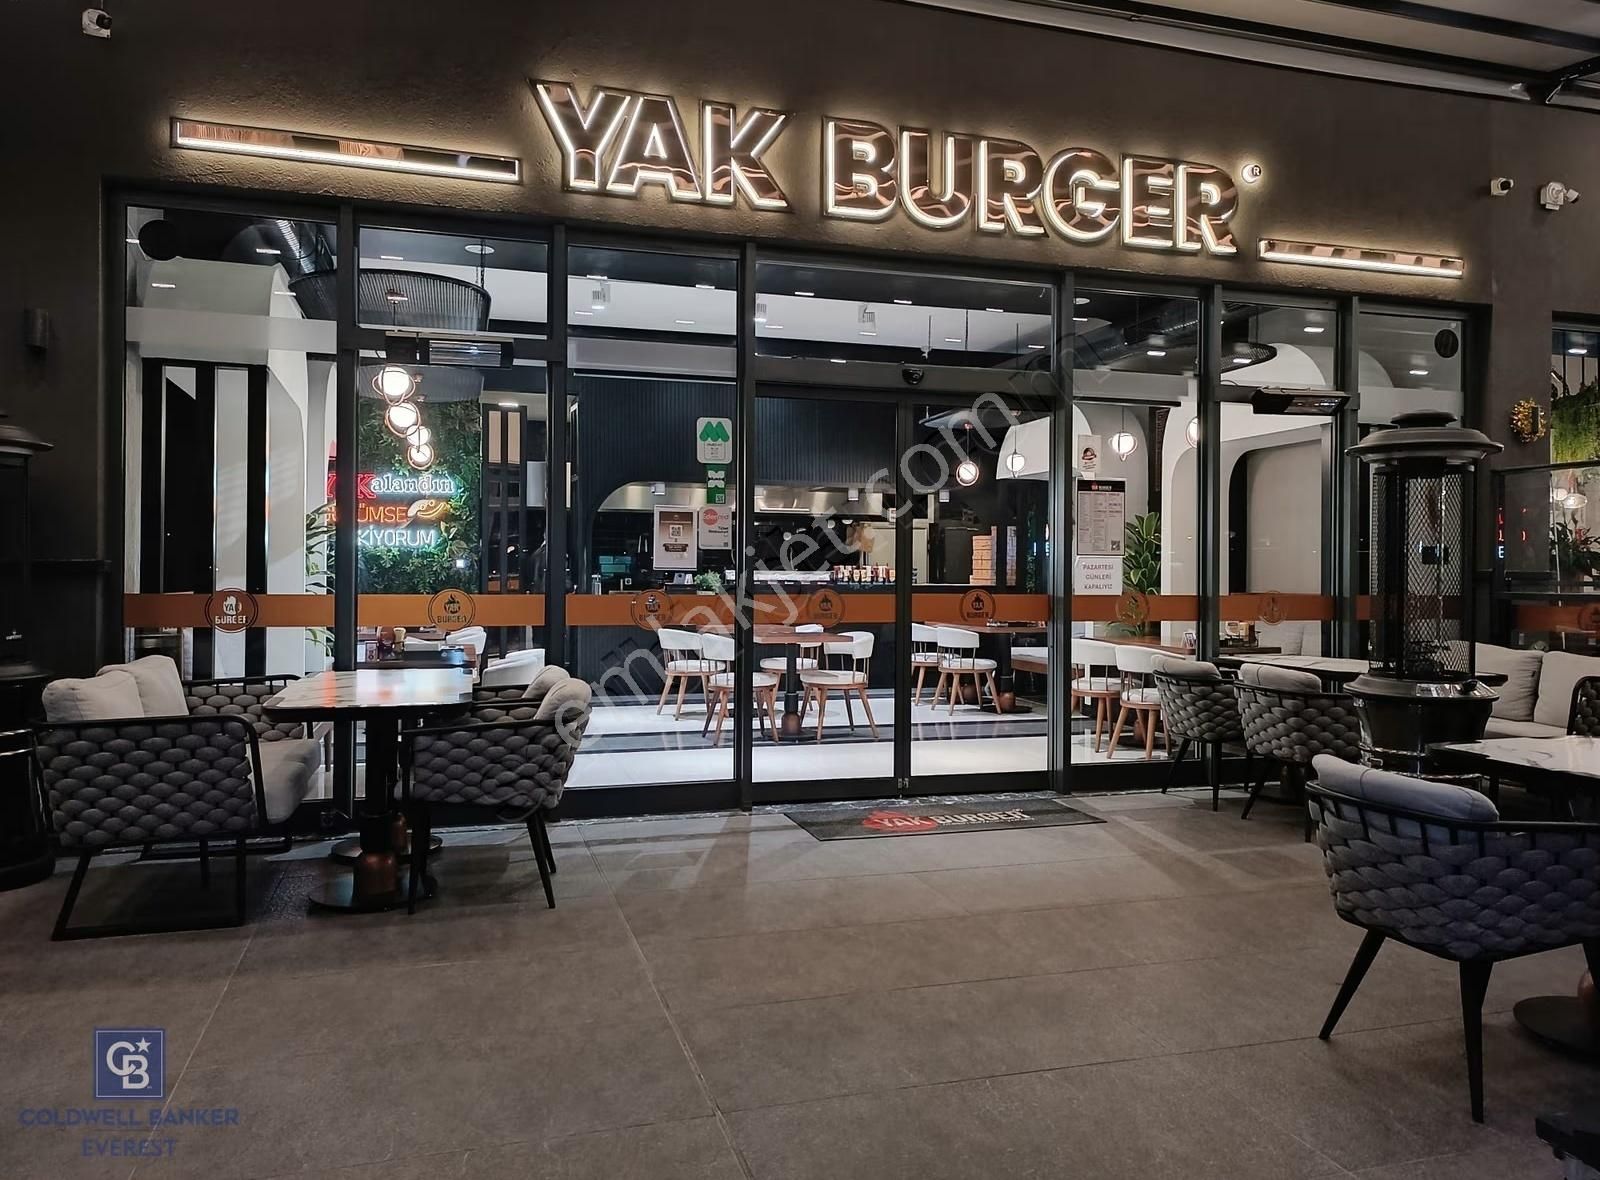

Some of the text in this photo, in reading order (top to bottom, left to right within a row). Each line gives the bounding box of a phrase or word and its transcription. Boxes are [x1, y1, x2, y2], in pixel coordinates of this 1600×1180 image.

[528, 80, 795, 212] YAK
[821, 115, 1239, 257] BURGER
[327, 472, 456, 498] Kalandın
[357, 525, 435, 546] KİYORUM
[875, 816, 930, 828] YAK
[930, 810, 1031, 824] BURGER
